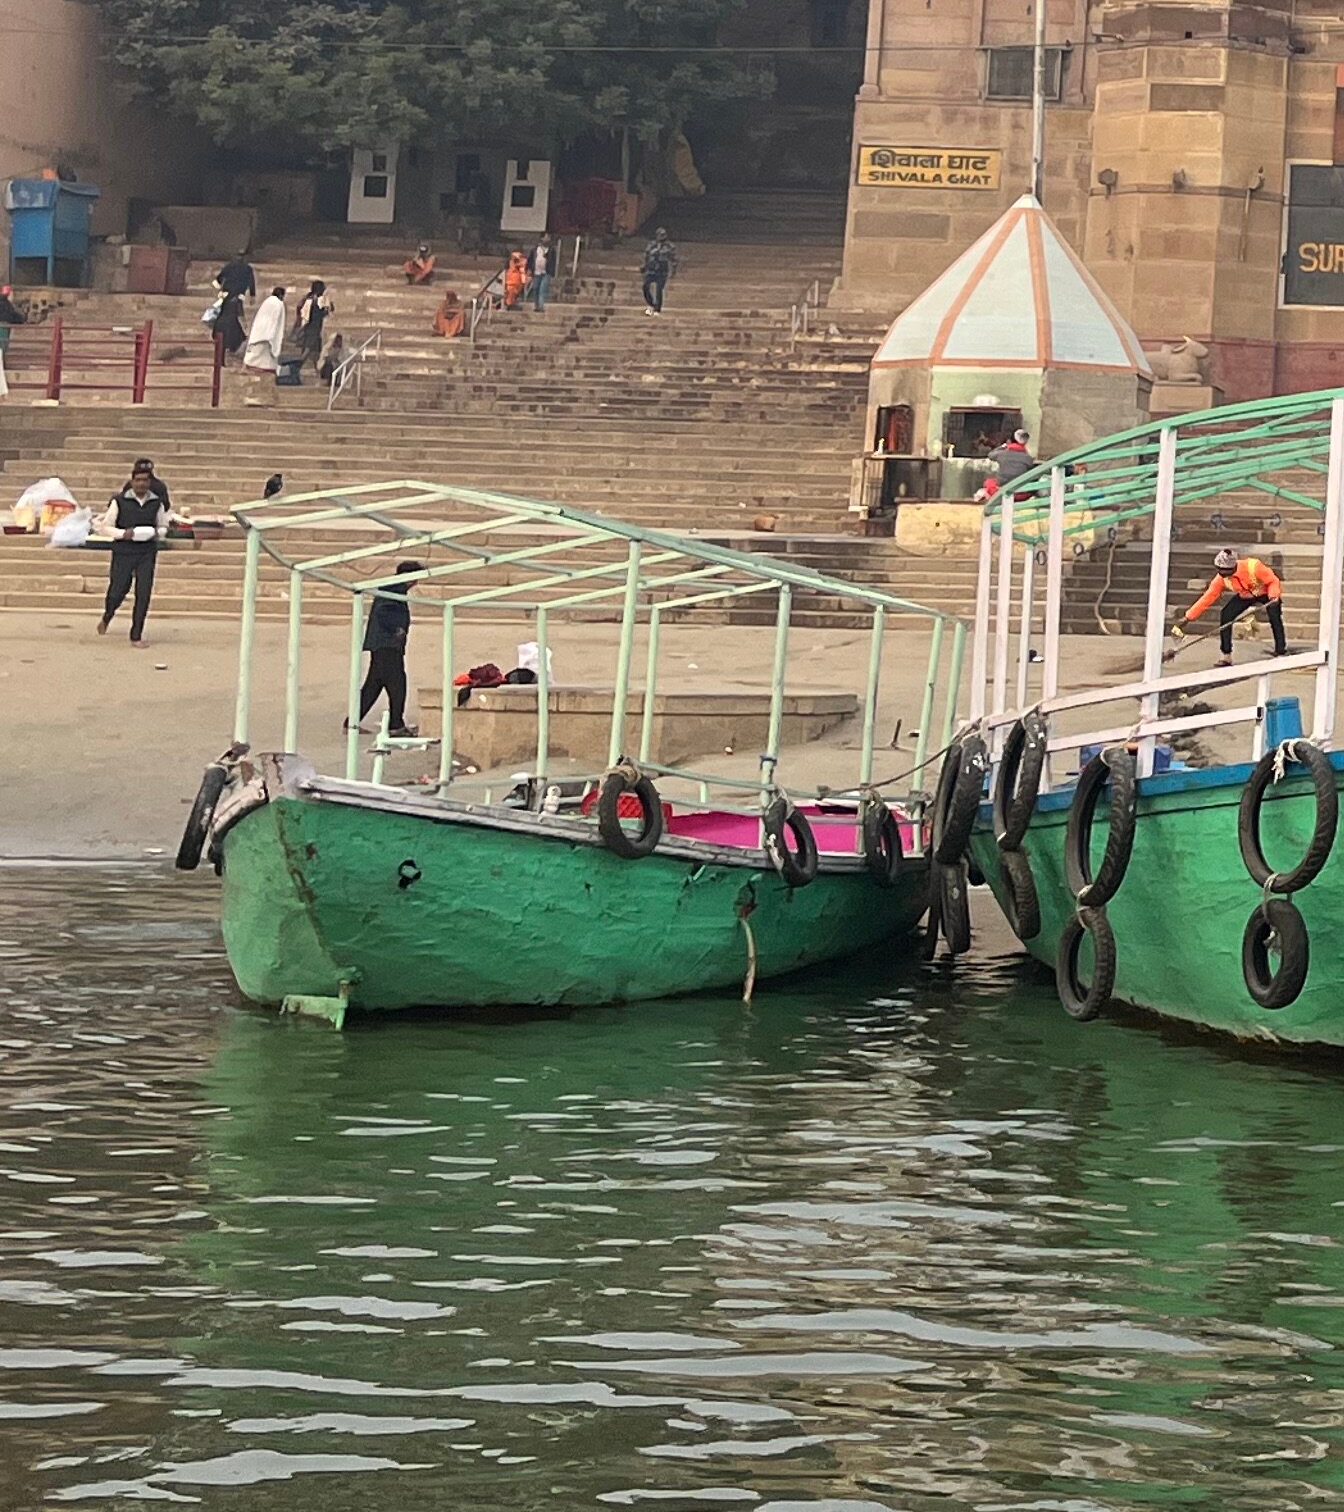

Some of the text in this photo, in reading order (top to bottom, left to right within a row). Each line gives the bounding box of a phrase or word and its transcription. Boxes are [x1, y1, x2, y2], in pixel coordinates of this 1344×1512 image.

[869, 149, 991, 171] शिवाला घाट
[868, 170, 992, 185] SHIVALA GHAT
